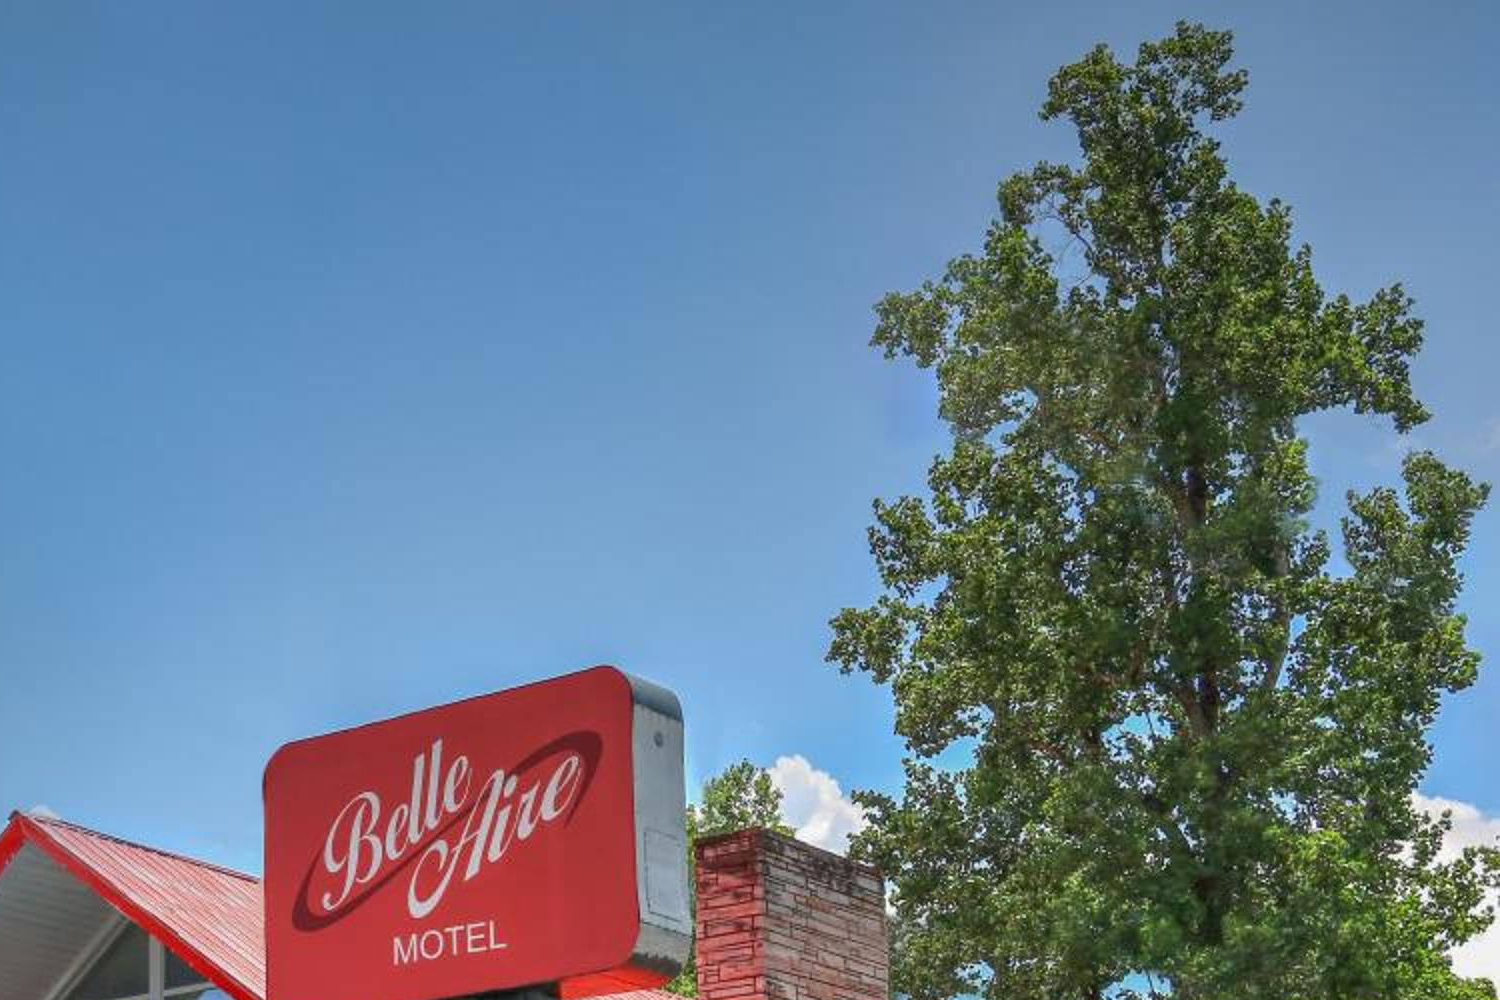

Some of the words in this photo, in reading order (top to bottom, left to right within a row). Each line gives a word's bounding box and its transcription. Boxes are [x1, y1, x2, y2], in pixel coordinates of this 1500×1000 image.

[322, 738, 473, 911] Belle
[407, 755, 582, 919] Aire
[393, 920, 507, 965] MOTEL
